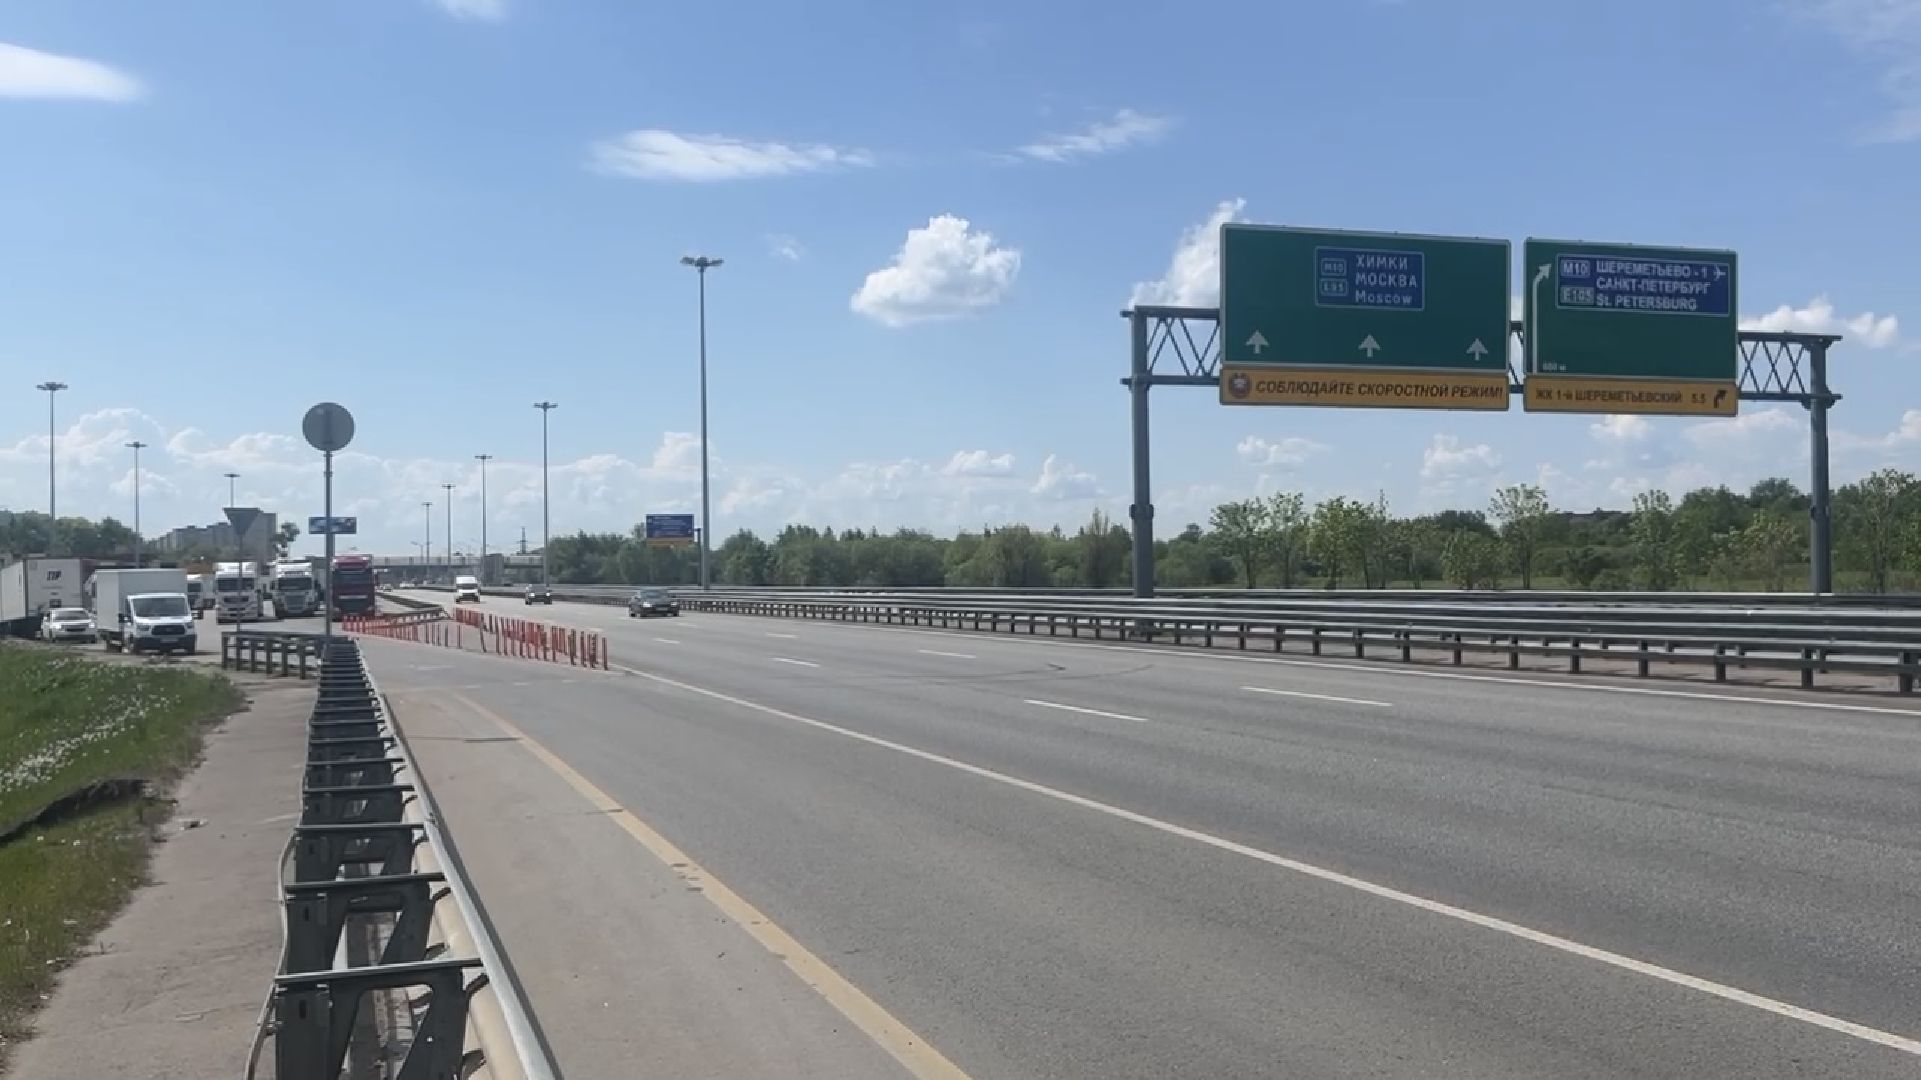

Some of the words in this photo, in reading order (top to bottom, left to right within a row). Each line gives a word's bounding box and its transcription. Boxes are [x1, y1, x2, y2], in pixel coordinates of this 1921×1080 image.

[1356, 254, 1408, 270] ХИМКИ
[1596, 259, 1691, 278] ШЕРЕМЕТЬЕВО
[1355, 272, 1417, 288] МОСКВА
[1596, 275, 1711, 294] САНКТ-ПЕТЕРБУРГ
[1355, 289, 1413, 305] Moscow
[1616, 294, 1697, 311] PETERSBURG
[1256, 380, 1354, 397] СОБЛЮДАЙТЕ
[1358, 382, 1449, 397] СКОРОСТНОЙ
[1452, 385, 1503, 398] РЕЖИМ!
